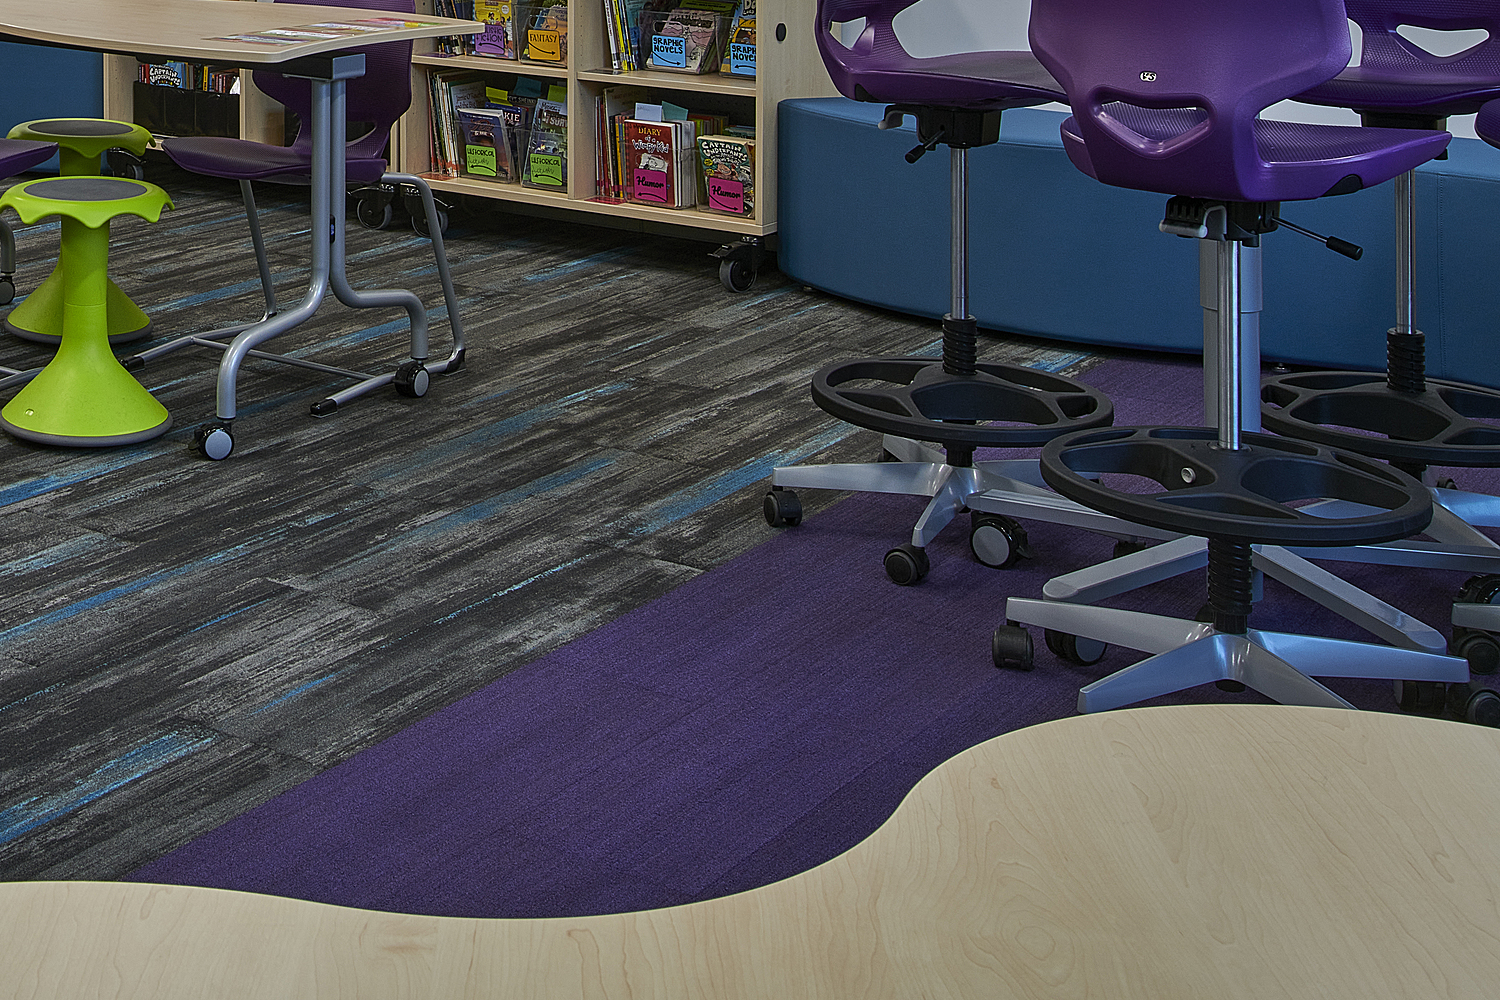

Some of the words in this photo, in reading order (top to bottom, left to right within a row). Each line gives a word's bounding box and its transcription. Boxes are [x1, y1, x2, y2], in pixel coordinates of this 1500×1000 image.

[530, 34, 557, 43] FANTASY
[638, 127, 661, 136] DIARY
[636, 176, 664, 189] Humor
[711, 185, 741, 199] Humor
